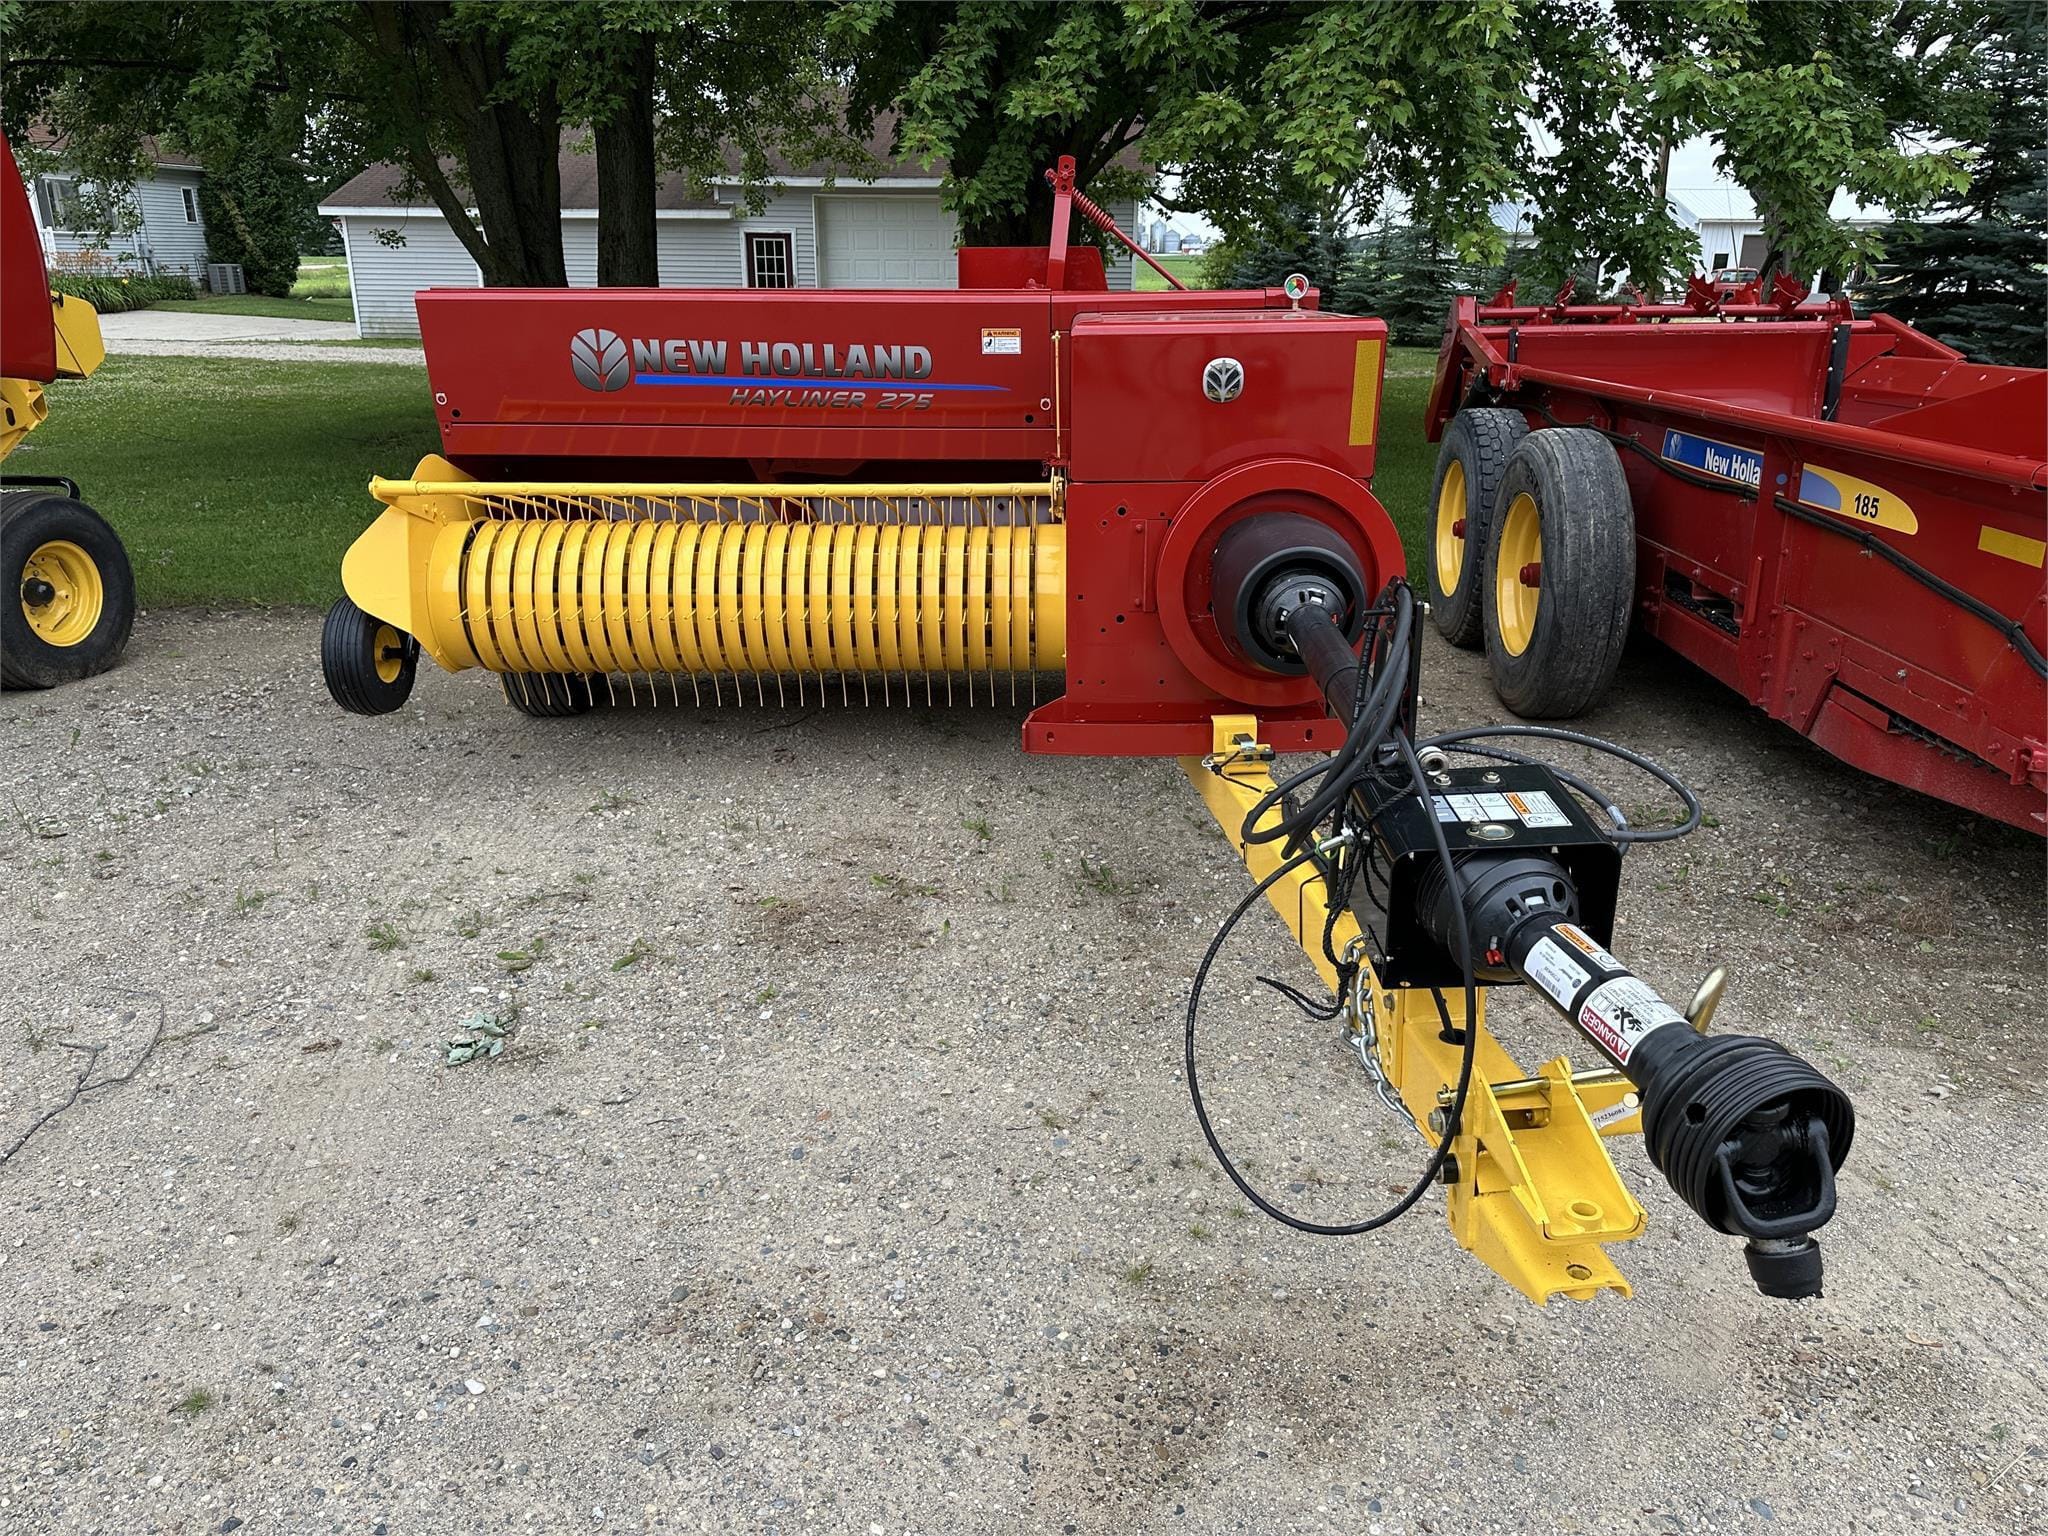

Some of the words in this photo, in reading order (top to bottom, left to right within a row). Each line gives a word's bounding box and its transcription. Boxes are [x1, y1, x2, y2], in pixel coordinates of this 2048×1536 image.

[632, 338, 727, 374] NEW
[740, 341, 933, 379] HOLLAND
[728, 388, 867, 408] HAYLINER
[875, 392, 935, 411] 275
[1704, 447, 1730, 475] New
[1854, 493, 1880, 518] 185
[1582, 1008, 1618, 1048] DANGER
